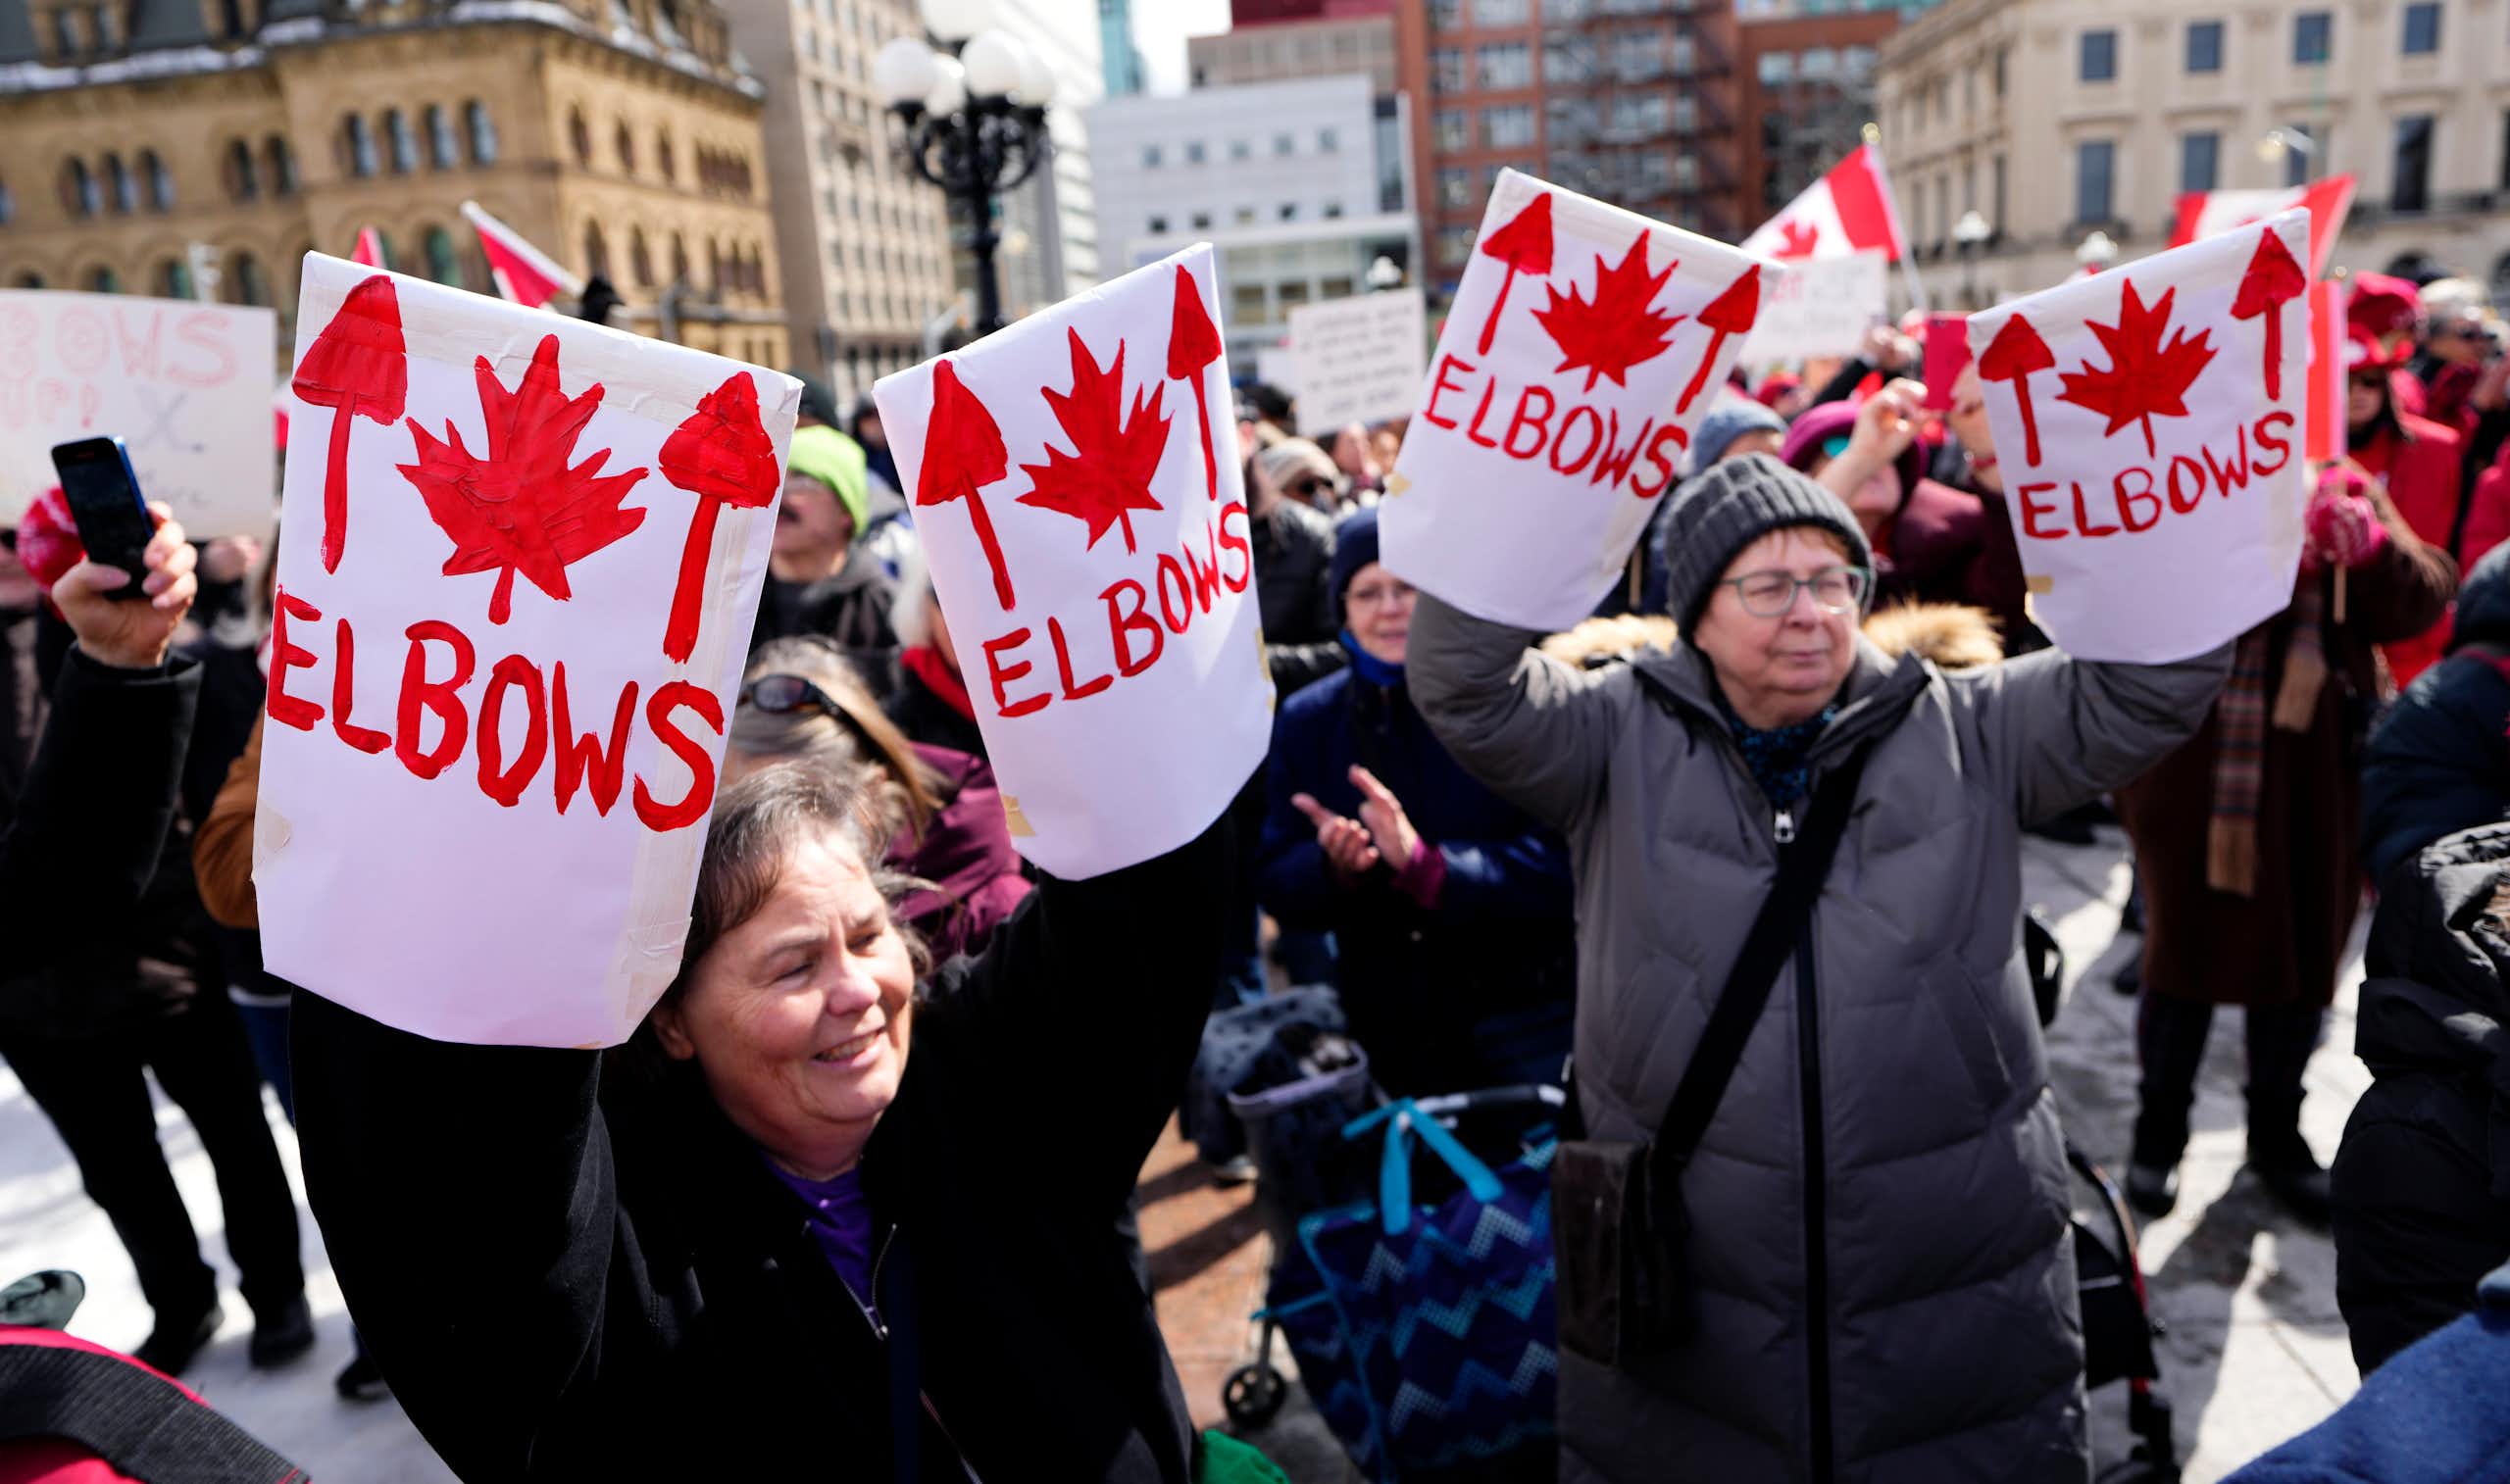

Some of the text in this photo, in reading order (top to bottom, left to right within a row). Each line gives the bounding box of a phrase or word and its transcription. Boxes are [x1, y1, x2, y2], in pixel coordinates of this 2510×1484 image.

[1422, 351, 1689, 500] ELBOWS
[2017, 410, 2296, 541] ELBOWS
[981, 501, 1251, 722] ELBOWS
[265, 583, 727, 834] ELBOWS
